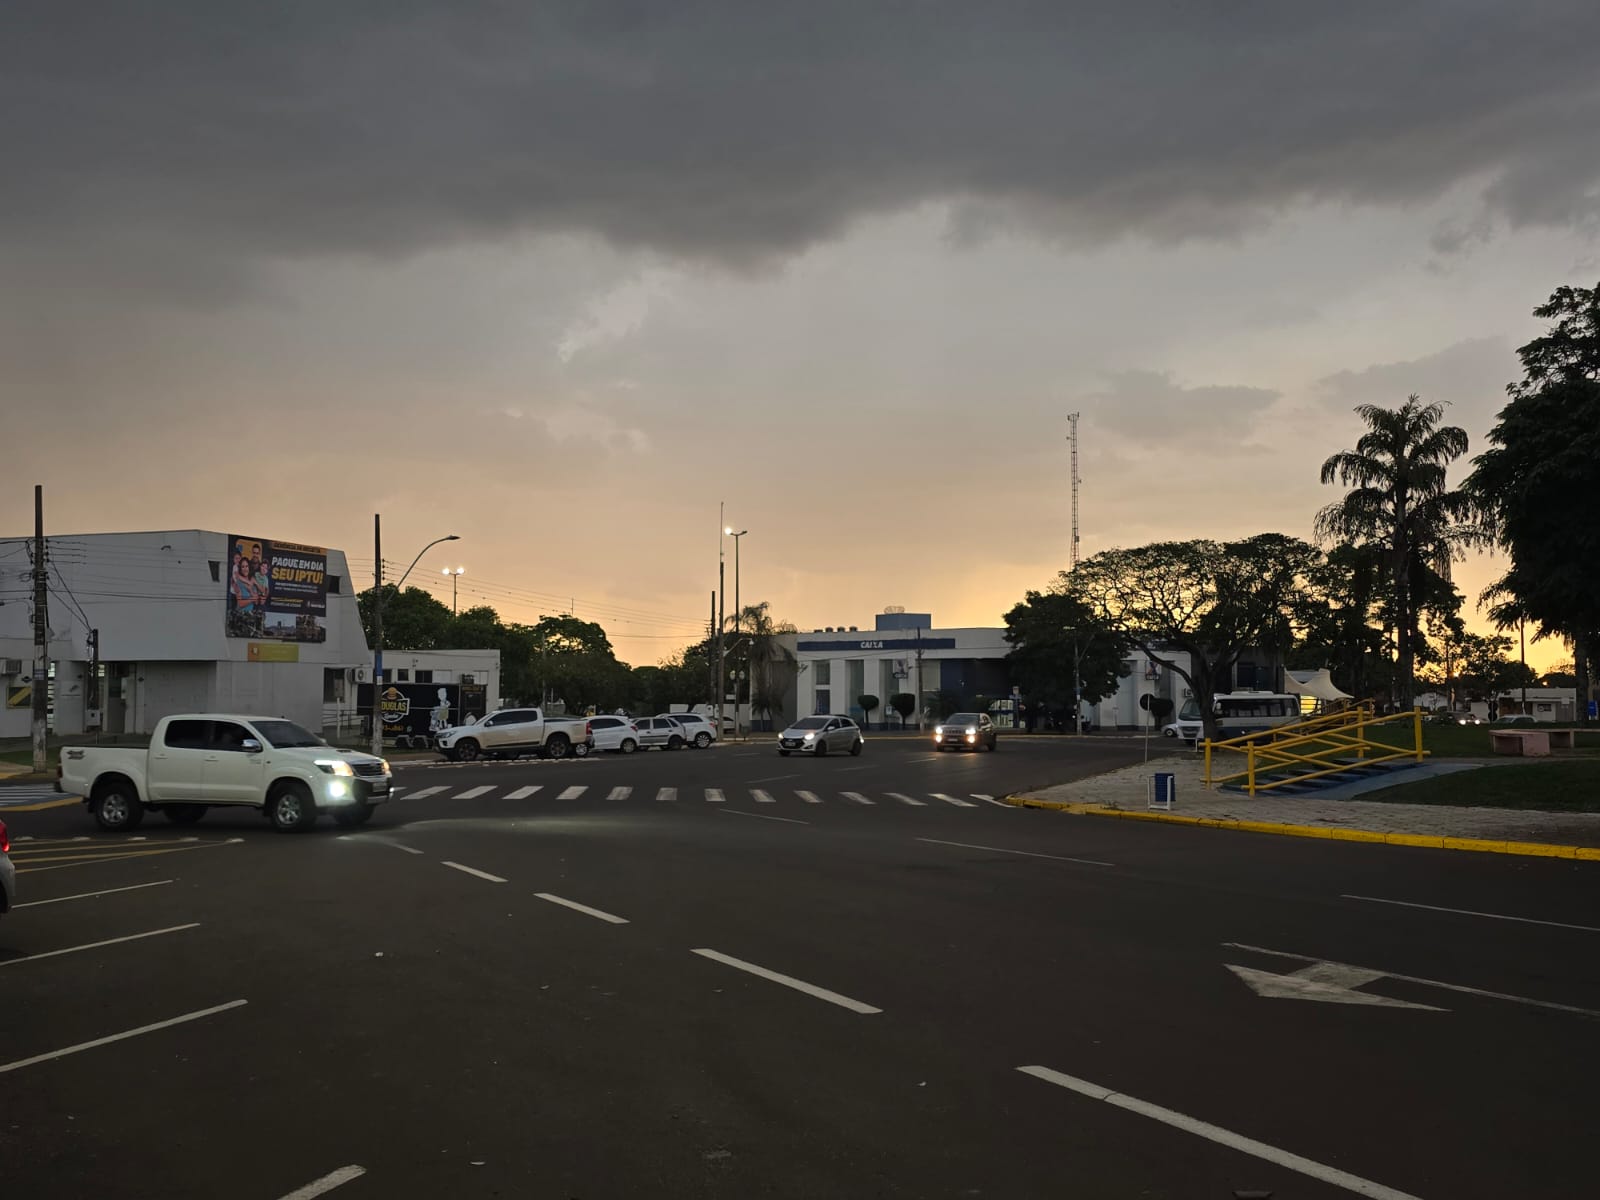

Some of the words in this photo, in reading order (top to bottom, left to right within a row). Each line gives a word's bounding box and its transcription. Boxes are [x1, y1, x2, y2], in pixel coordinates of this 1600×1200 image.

[272, 557, 299, 568] PAGUE
[299, 560, 311, 570] EM
[311, 561, 324, 571] DIA
[272, 567, 295, 581] SEU
[295, 570, 323, 584] IPTU!
[860, 641, 883, 649] CAIXA
